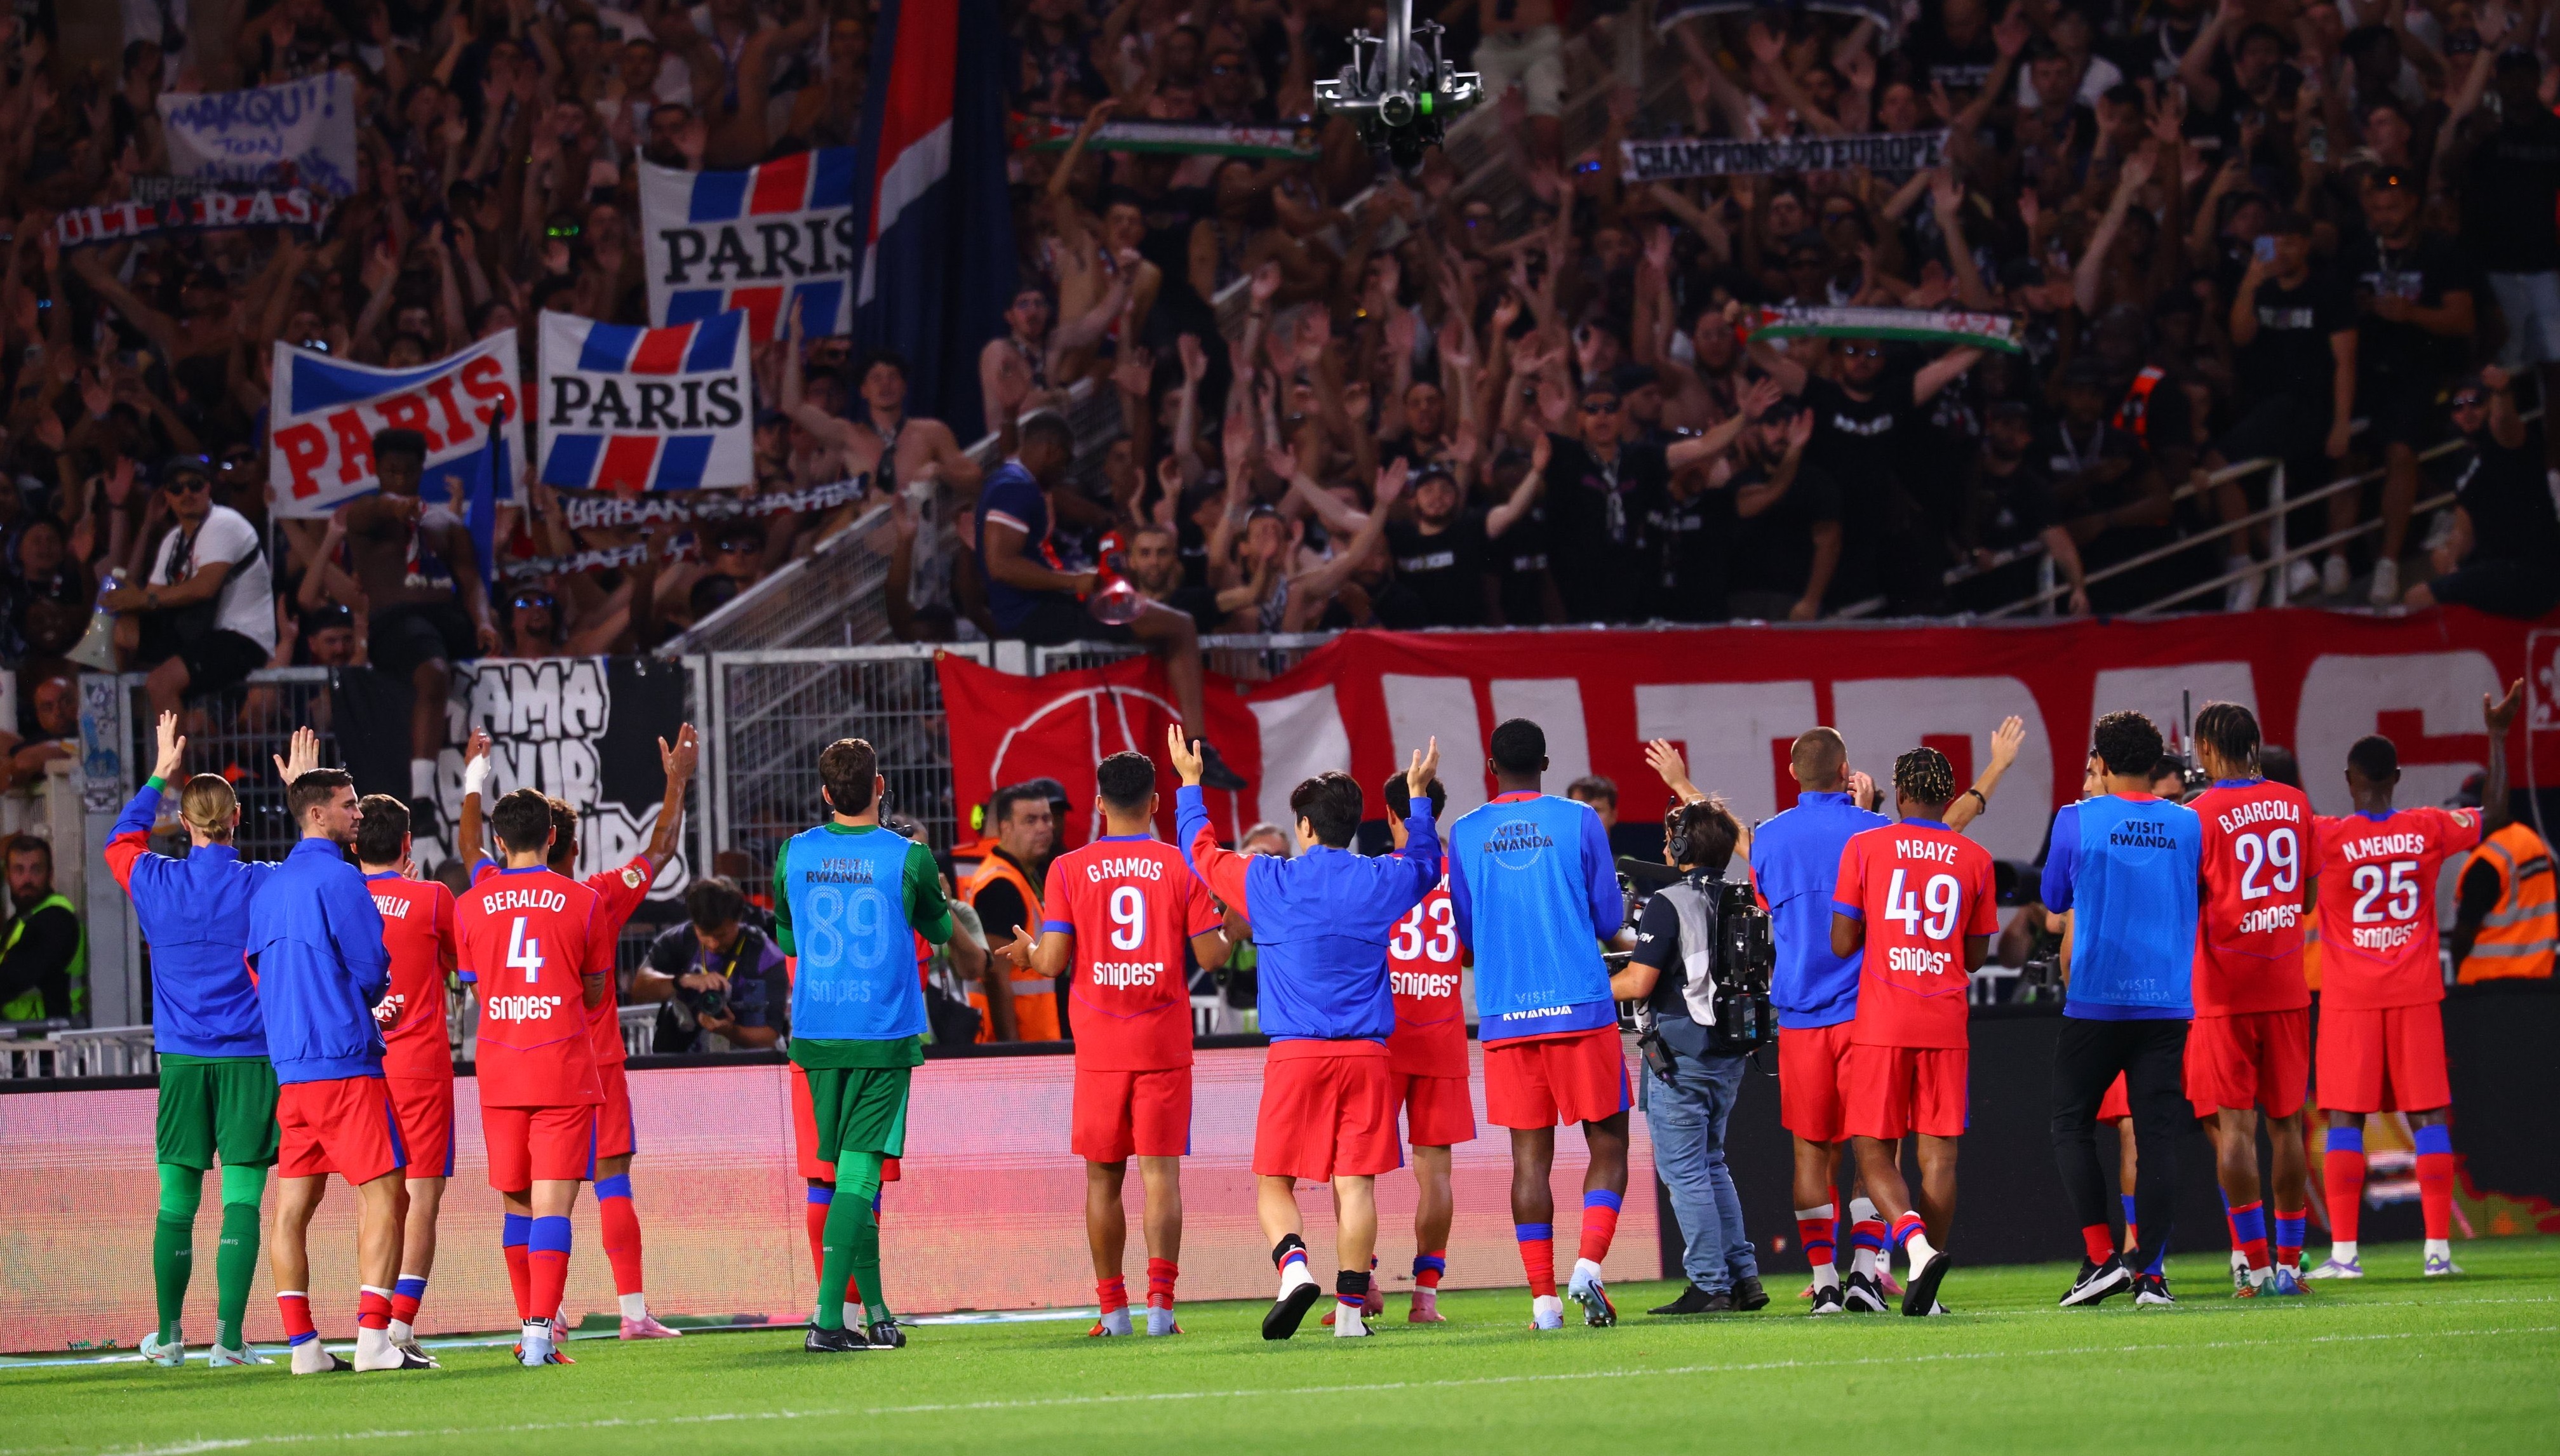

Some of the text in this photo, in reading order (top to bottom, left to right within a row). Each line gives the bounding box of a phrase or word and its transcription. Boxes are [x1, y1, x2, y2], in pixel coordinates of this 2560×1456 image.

[550, 377, 742, 430] PARIS
[274, 354, 516, 500] PARIS
[1497, 822, 1539, 838] VISIT
[2125, 820, 2165, 835] VISIT
[2218, 799, 2300, 834] B.BARCOLA
[1484, 834, 1554, 853] RWANDA
[1895, 839, 1959, 865] MBAYE
[2110, 833, 2177, 850] RWANDA
[2342, 833, 2425, 863] N.MENDES
[805, 871, 874, 885] RWANDA
[821, 857, 862, 871] VISIT
[1087, 857, 1163, 883] G.RAMOS
[2235, 827, 2300, 900] 29
[483, 888, 566, 916] BERALDO
[1884, 869, 1962, 940] 49
[2352, 860, 2420, 923] 25
[804, 885, 889, 970] 89
[1110, 885, 1146, 951] 9
[1390, 898, 1459, 963] 33
[2239, 902, 2298, 934] snipes
[506, 916, 546, 983] 4
[1888, 946, 1946, 977] snipes
[1092, 961, 1157, 991] snipes
[1390, 971, 1453, 1001] snipes
[488, 994, 554, 1025] snipes
[1515, 989, 1556, 1005] VISIT
[1502, 1005, 1573, 1022] RWANDA
